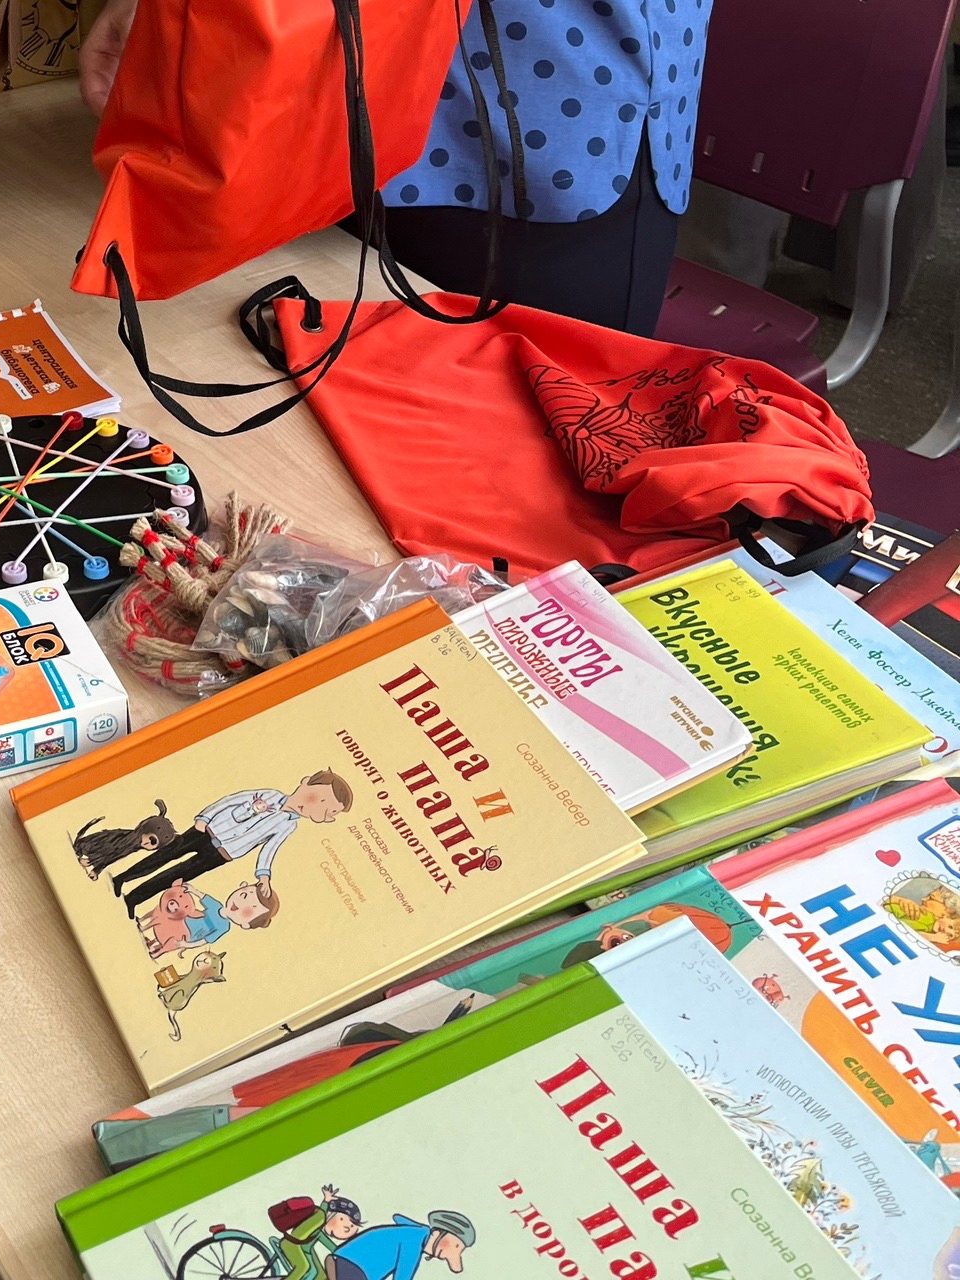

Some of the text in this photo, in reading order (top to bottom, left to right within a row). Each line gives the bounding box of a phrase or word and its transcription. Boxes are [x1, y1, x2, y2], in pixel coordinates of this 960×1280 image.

[1, 349, 40, 395] библиотека
[32, 339, 77, 389] центральная
[3, 633, 29, 665] БЛОК
[17, 623, 65, 661] IQ
[494, 617, 579, 700] ПИРОЖНЫЕ
[520, 598, 623, 689] ТОРТЫ
[649, 587, 761, 686] Вкусные
[826, 619, 863, 650] Хелен
[867, 650, 912, 688] Фостер
[92, 718, 113, 731] 120
[378, 663, 490, 782] Паша
[670, 695, 703, 726] ВКУСНЫЕ
[771, 653, 862, 729] ярких рецептов
[788, 647, 875, 724] коллекция самых
[670, 711, 702, 740] ШТУЧКИ
[335, 727, 457, 896] говорят о животных
[397, 760, 487, 878] папа
[515, 742, 560, 792] Сюзанна
[556, 788, 592, 829] Вебер
[347, 824, 416, 915] для семейного чтения
[362, 817, 392, 856] Рассказы
[743, 893, 881, 1036] ХРАНИТЬ
[800, 883, 920, 979] НЕ
[843, 1056, 895, 1108] CLEVER
[534, 1053, 700, 1240] Паша
[755, 1064, 907, 1219] ИЛЛЮСТРАЦИИ ЛИЗЫ ТРЕТЬЯКОВОЙ
[498, 1178, 590, 1280] в доро
[577, 1202, 658, 1280] па
[730, 1187, 798, 1265] Сюзанна
